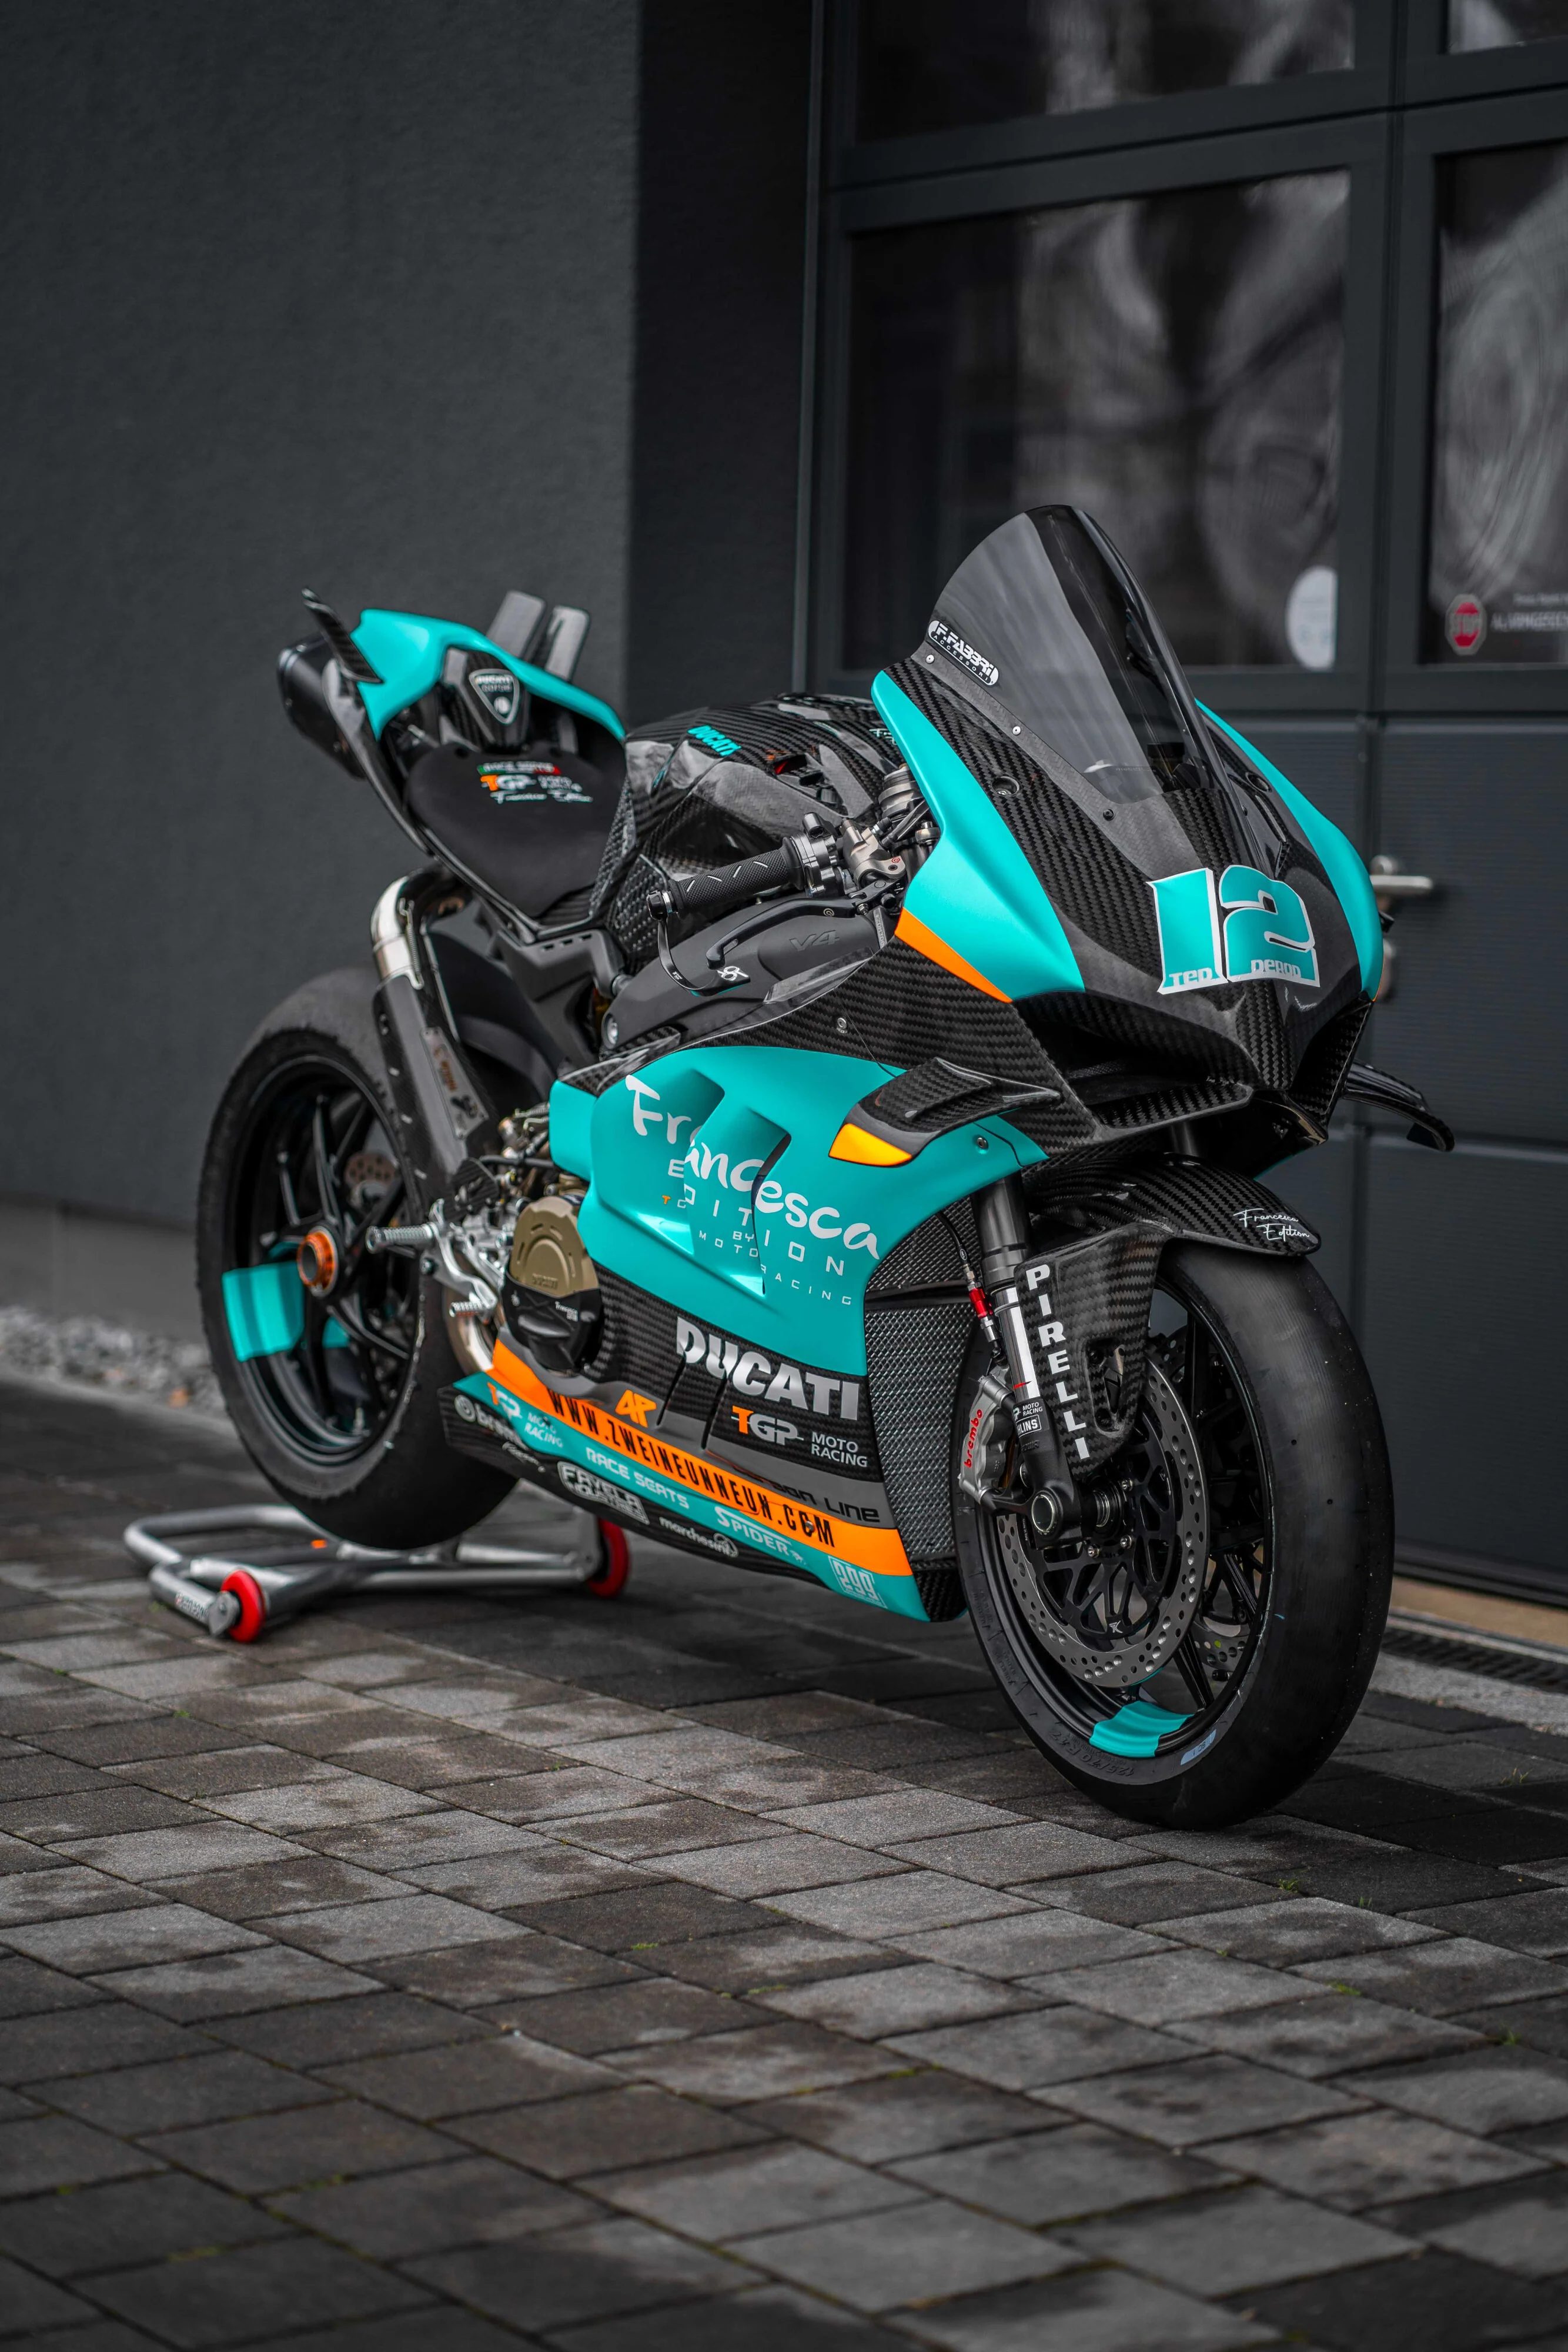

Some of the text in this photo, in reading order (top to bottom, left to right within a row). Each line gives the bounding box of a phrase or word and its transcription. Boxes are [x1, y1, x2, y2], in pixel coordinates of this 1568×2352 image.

[934, 635, 988, 681] ACCESSORI
[687, 725, 741, 757] DUCATI
[789, 929, 840, 951] V4
[1145, 865, 1320, 994] 12
[668, 1158, 845, 1277] EDITION
[1233, 1208, 1299, 1228] Francesca
[733, 1231, 755, 1243] BY
[1256, 1223, 1310, 1242] Edition
[677, 1317, 860, 1421] DUCATI
[1025, 1264, 1089, 1460] PIRELLI
[1022, 1402, 1039, 1411] MOTO
[1023, 1406, 1043, 1416] RACING
[527, 1412, 557, 1434] MOO
[731, 1405, 804, 1446] TGP
[1017, 1418, 1038, 1435] HLINS
[811, 1431, 858, 1453] MOTO
[964, 1409, 982, 1468] brembo
[811, 1444, 868, 1468] RACING
[586, 1446, 630, 1480] RACE
[633, 1471, 690, 1509] SEATS
[714, 1506, 792, 1556] SPIDER
